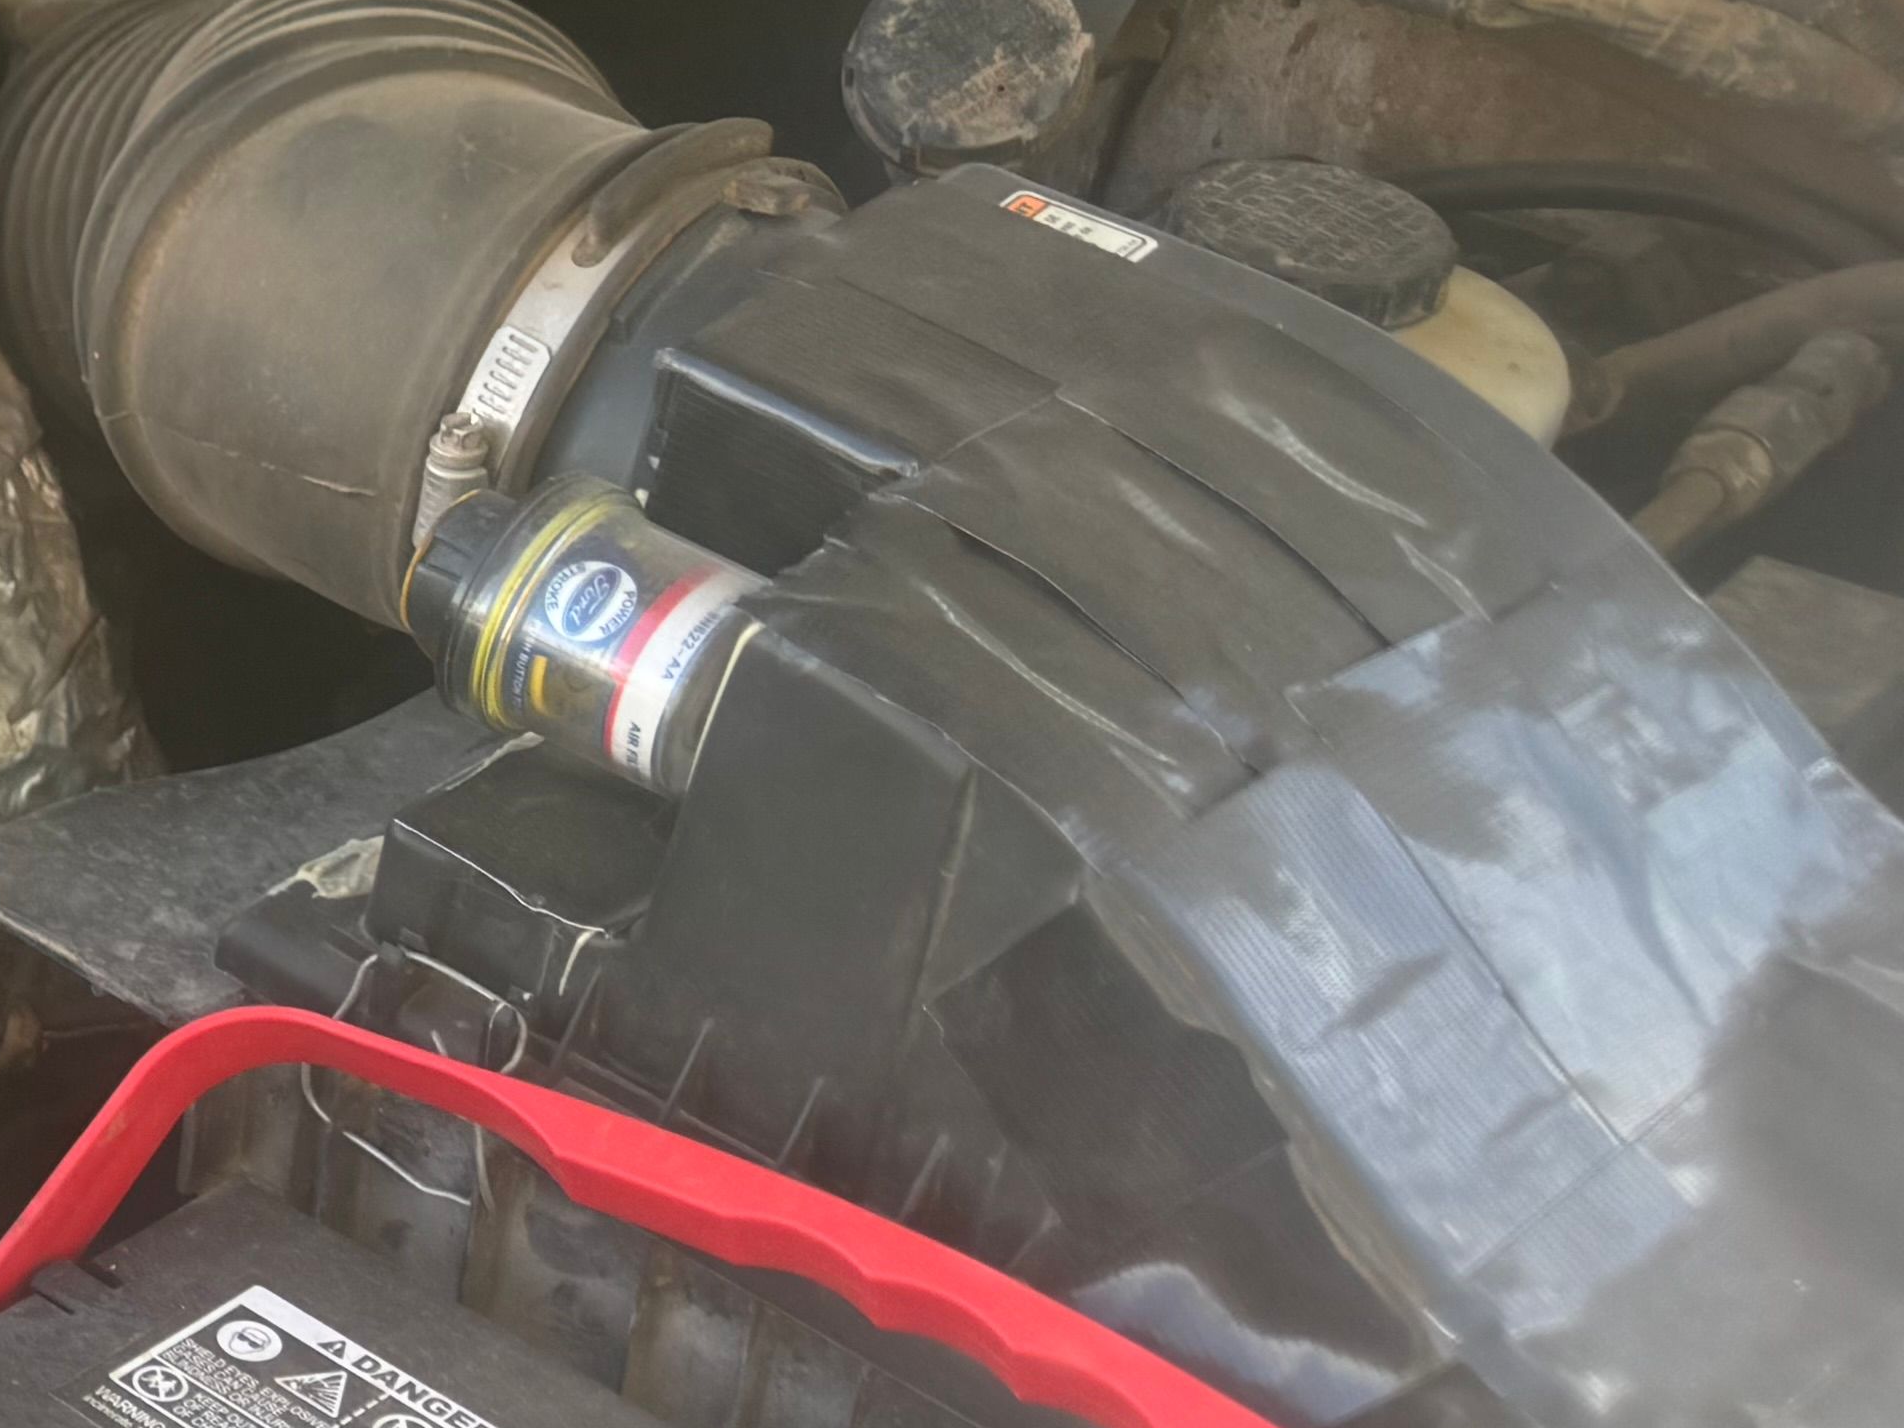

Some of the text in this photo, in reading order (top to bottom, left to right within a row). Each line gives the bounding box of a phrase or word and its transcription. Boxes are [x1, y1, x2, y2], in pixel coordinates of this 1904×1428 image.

[546, 562, 588, 611] STROKE
[569, 574, 611, 627] Ford
[599, 590, 636, 637] POWER
[626, 722, 642, 749] AIR
[179, 1337, 229, 1369] SHIELD
[181, 1399, 204, 1413] OF
[192, 1392, 230, 1416] KEEP
[211, 1370, 285, 1417] CAN CAUSE
[171, 1405, 194, 1420] OF
